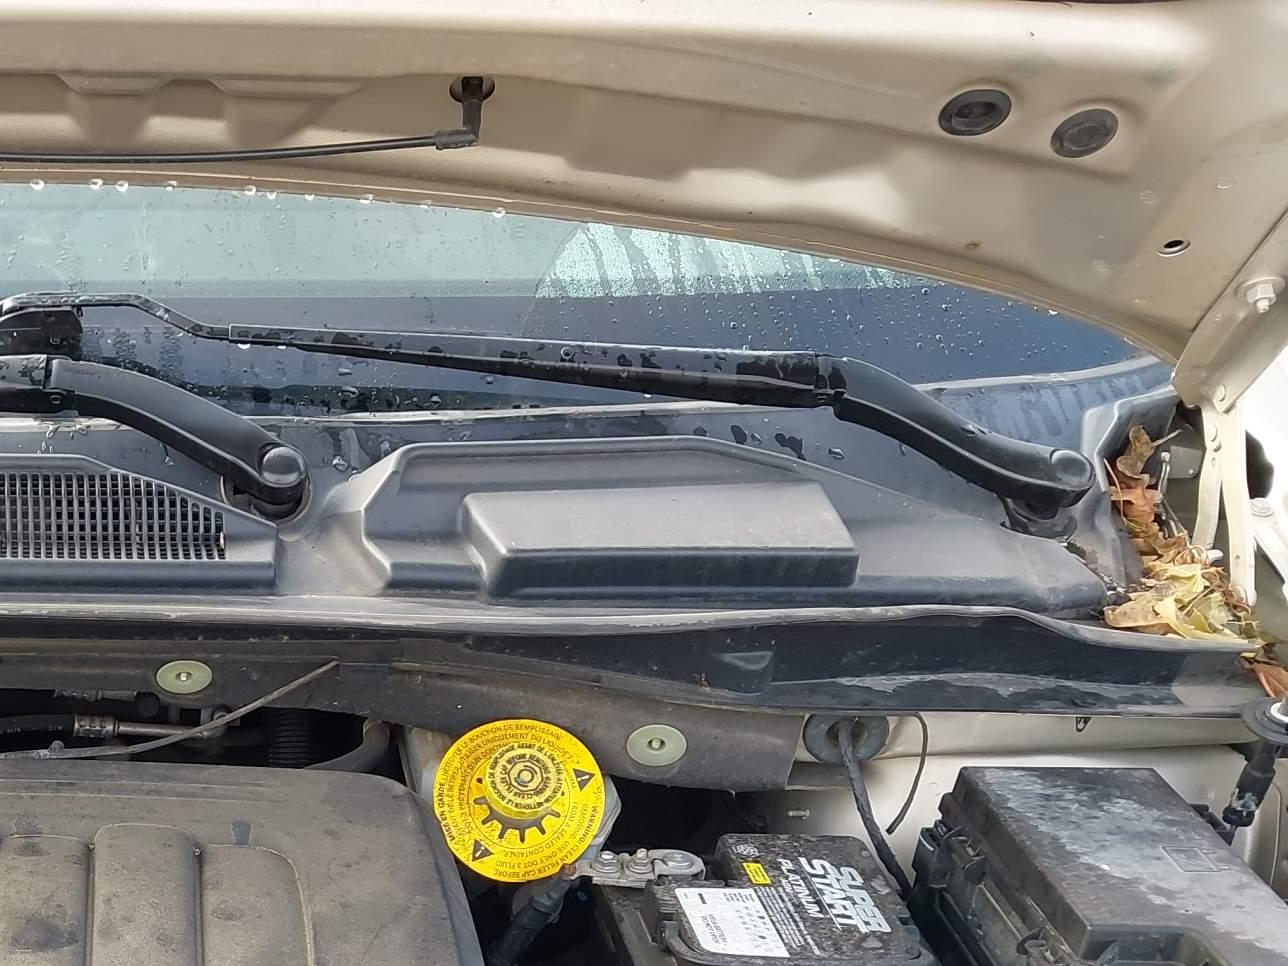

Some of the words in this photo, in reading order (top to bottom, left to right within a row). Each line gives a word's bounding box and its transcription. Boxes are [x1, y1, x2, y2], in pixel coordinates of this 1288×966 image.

[467, 724, 501, 744] BOUCHON
[523, 859, 538, 868] DOT
[776, 859, 825, 918] PLATINUM
[799, 857, 870, 934] START
[839, 866, 892, 932] SUPER
